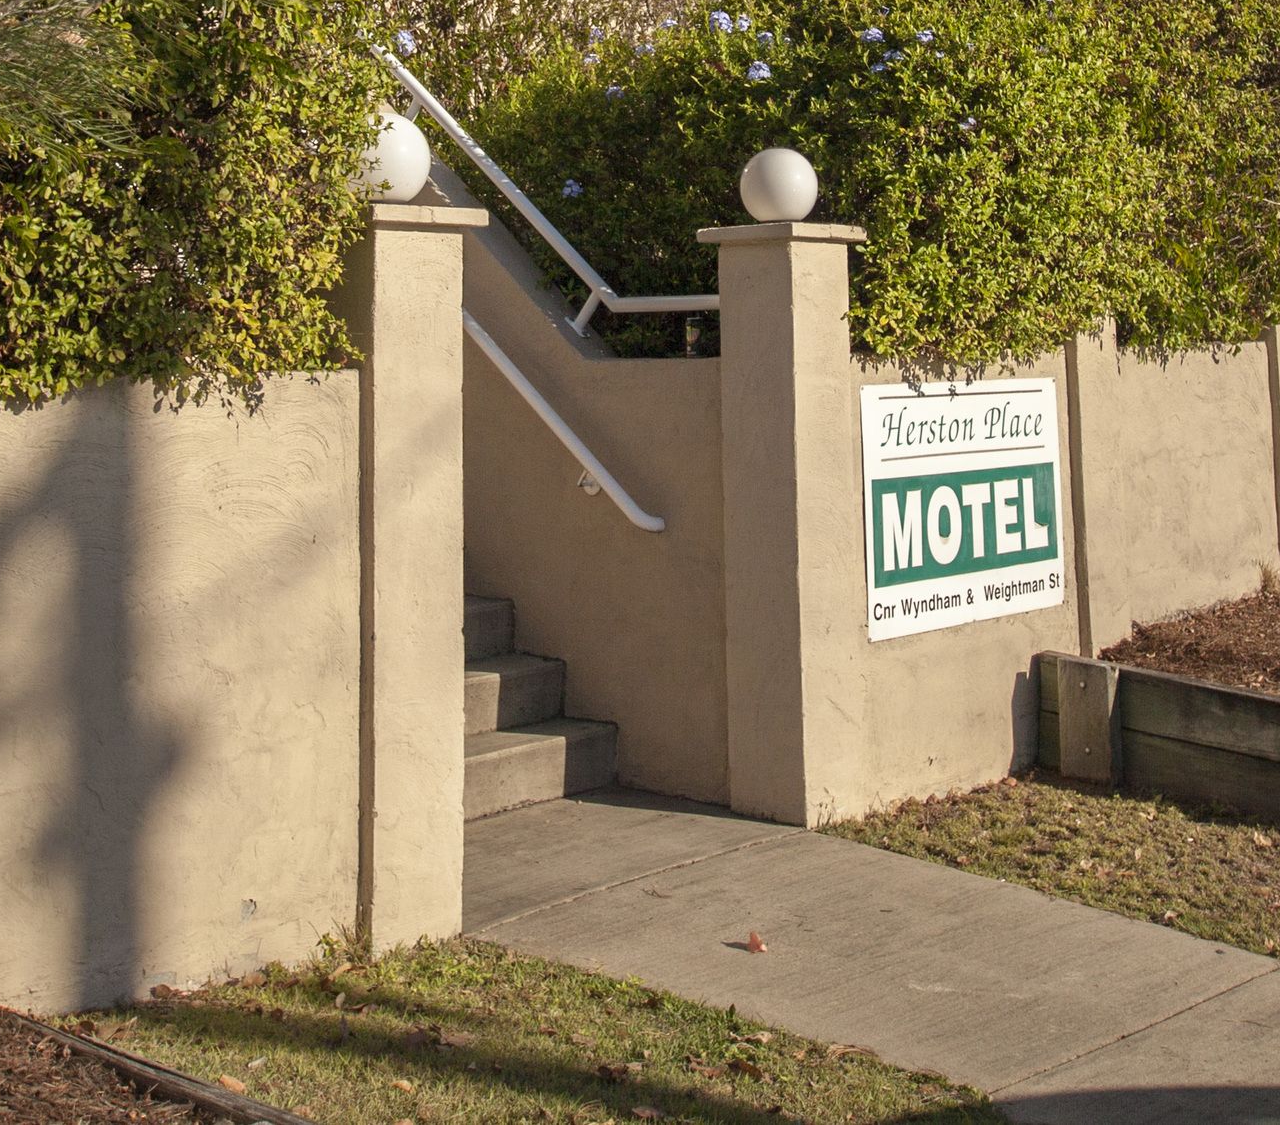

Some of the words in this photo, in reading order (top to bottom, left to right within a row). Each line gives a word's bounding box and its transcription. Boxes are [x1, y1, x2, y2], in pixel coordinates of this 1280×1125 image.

[880, 406, 975, 448] Herston
[984, 401, 1043, 440] Place
[881, 477, 1049, 572] MOTEL
[873, 601, 896, 621] Cnr
[900, 593, 961, 619] Wyndham
[966, 588, 974, 604] &
[984, 577, 1045, 602] Weightman
[1049, 573, 1060, 589] St
